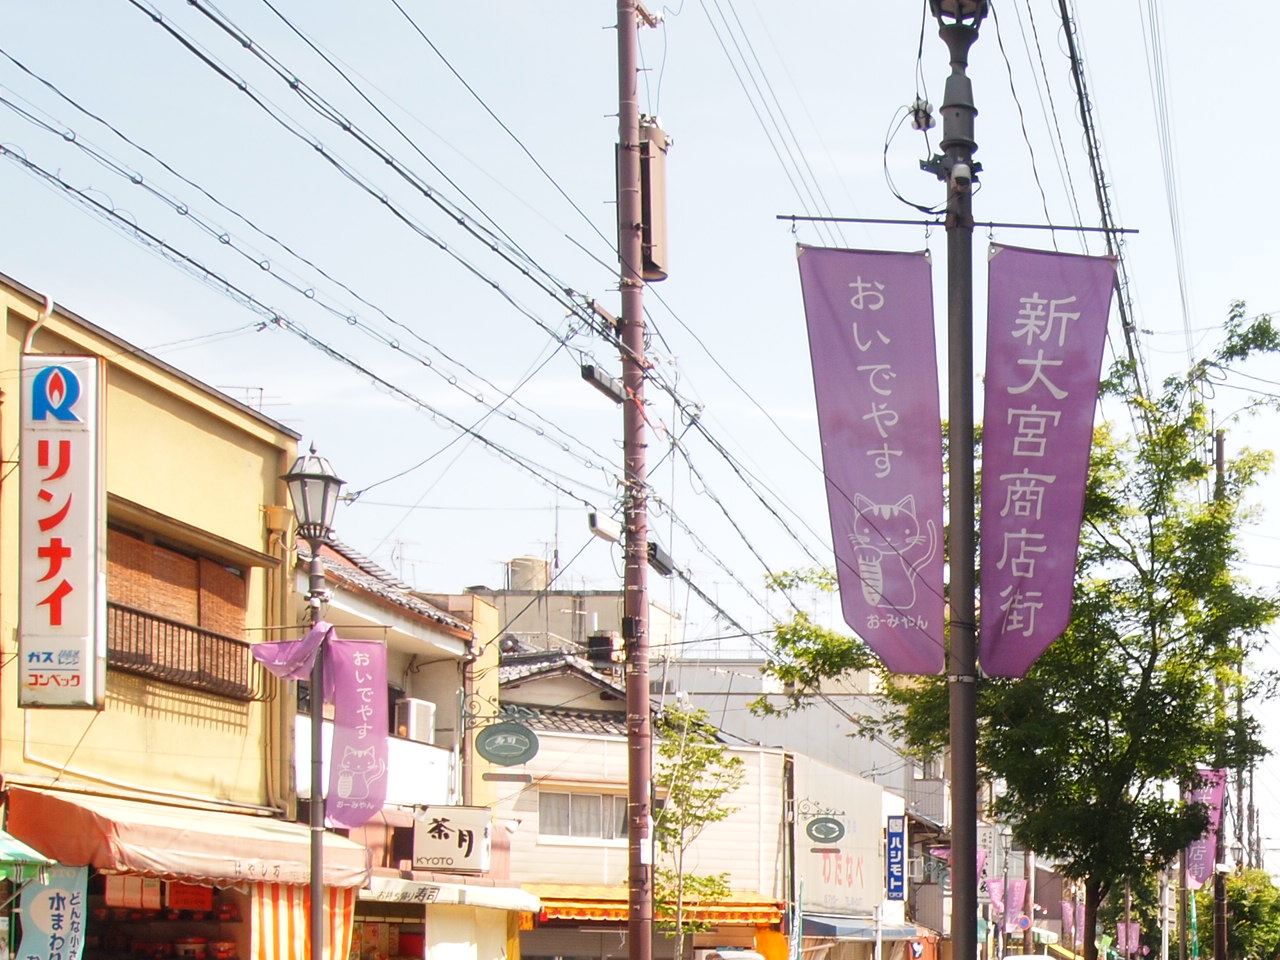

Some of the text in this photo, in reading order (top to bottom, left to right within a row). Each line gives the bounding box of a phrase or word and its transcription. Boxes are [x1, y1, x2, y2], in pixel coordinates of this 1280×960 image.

[848, 276, 902, 479] おいでやす
[995, 291, 1081, 638] 新大宮商店街
[36, 440, 73, 626] リンナイ
[866, 613, 929, 631] おーみやん
[28, 651, 54, 663] ガス
[353, 651, 374, 740] おいでやす
[416, 857, 454, 866] KYOTO
[427, 817, 474, 858] 茶月
